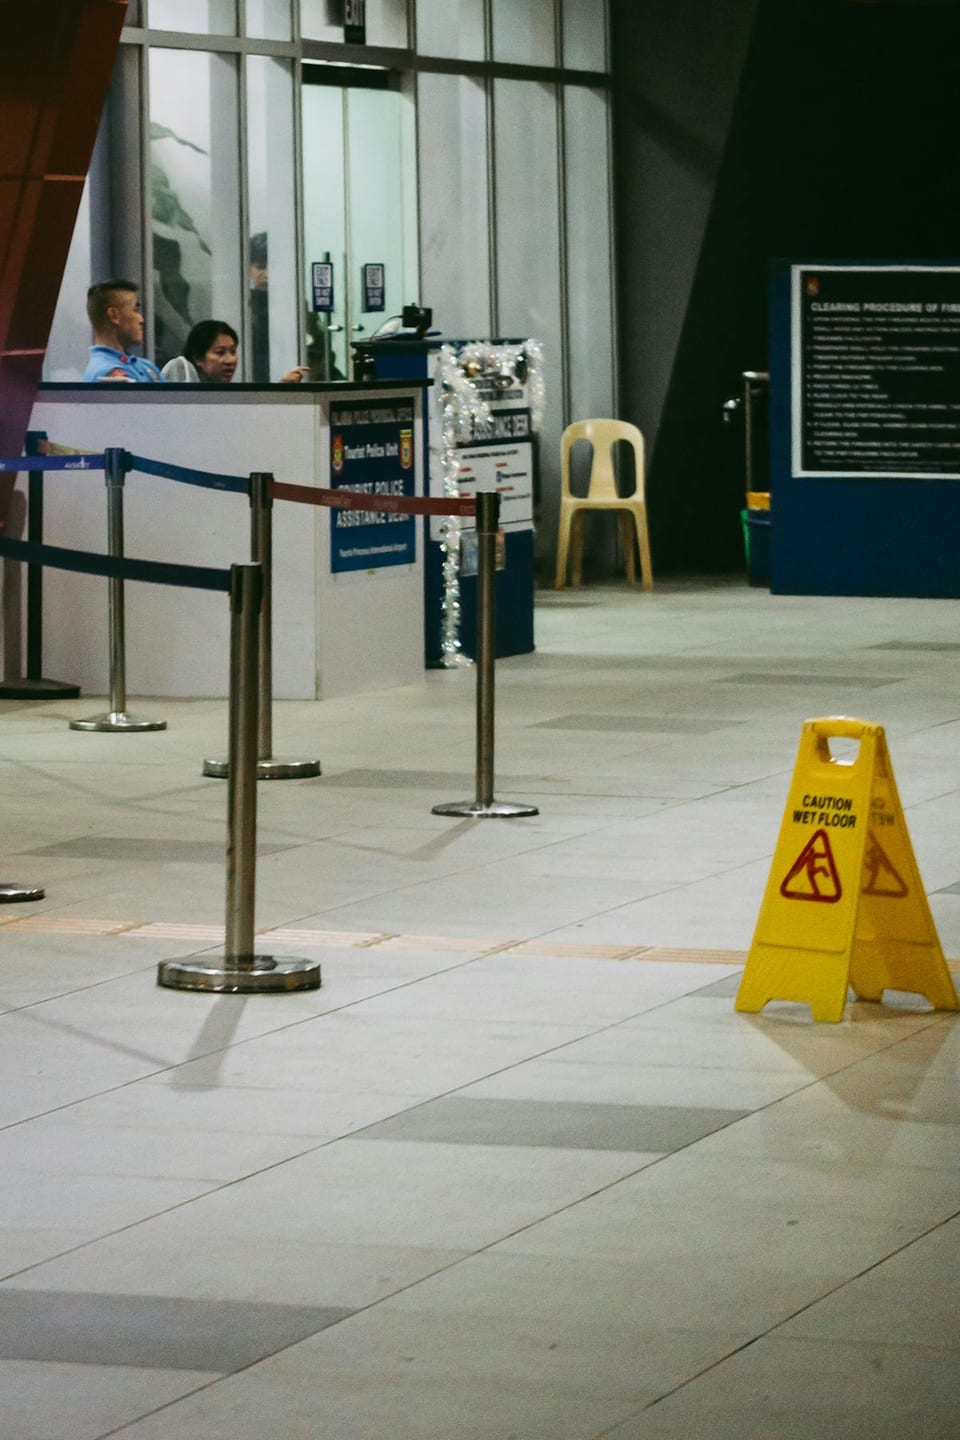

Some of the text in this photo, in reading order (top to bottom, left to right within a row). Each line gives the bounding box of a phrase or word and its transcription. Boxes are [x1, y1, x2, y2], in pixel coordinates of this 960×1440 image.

[811, 303, 860, 312] CLEARING
[863, 303, 922, 312] PROCEDURE
[926, 304, 937, 312] OF
[344, 442, 399, 459] Tourist Police Unit
[375, 479, 404, 496] POLICE
[336, 510, 386, 528] ASSISTANCE
[803, 794, 853, 811] CAUTION
[793, 809, 856, 828] WET FLOOR
